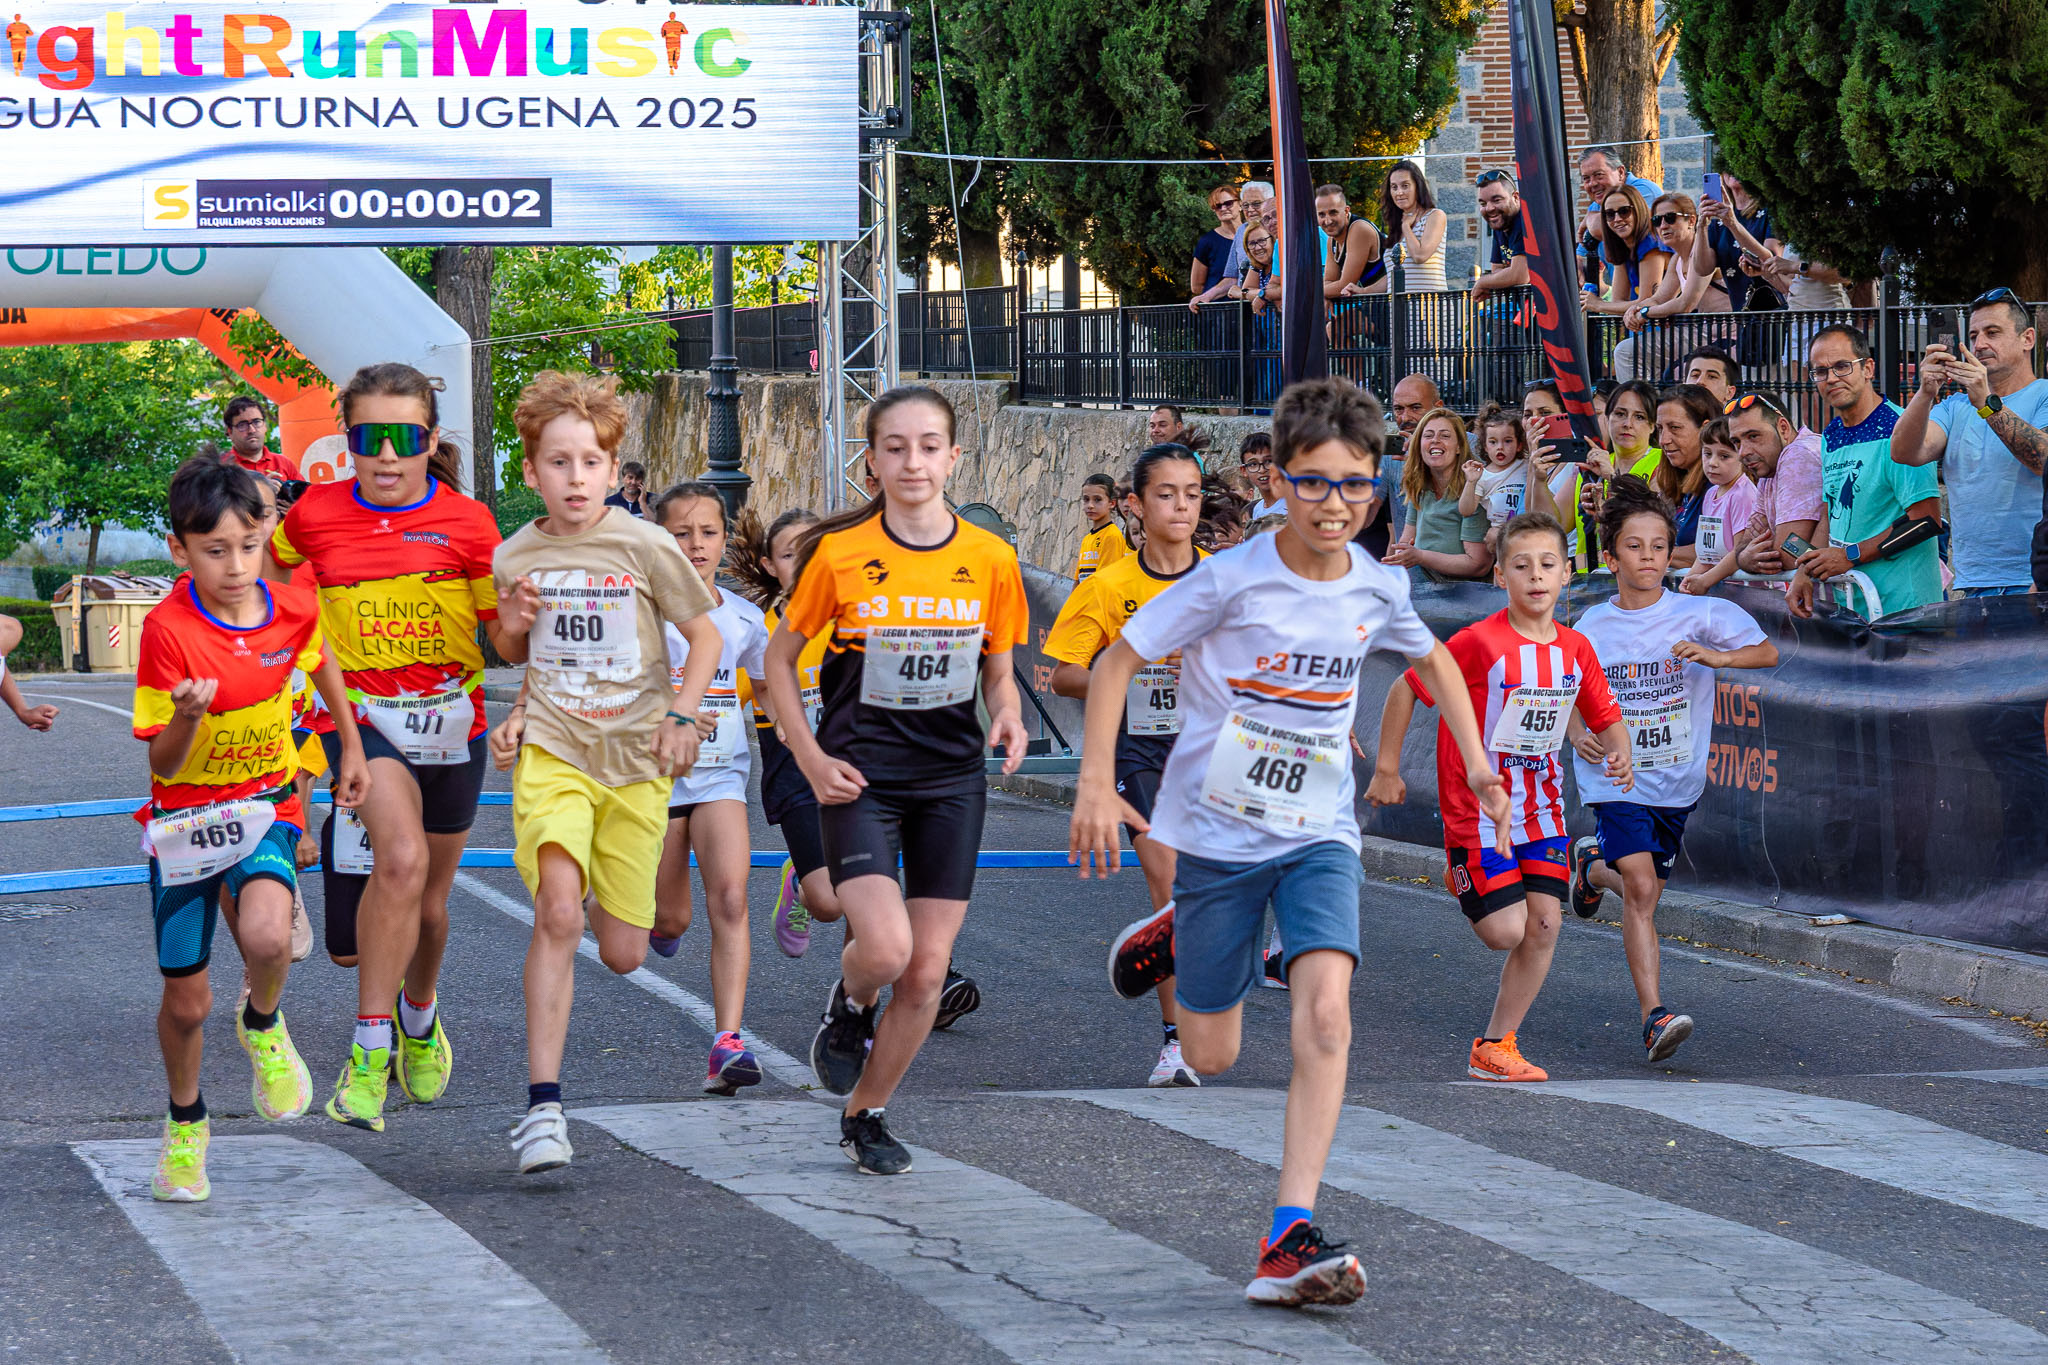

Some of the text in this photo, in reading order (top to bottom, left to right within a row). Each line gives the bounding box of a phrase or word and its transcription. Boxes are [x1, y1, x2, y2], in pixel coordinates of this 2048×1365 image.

[121, 97, 419, 129] NOCTURNA
[438, 97, 620, 129] UGENA
[637, 97, 757, 129] 2025
[200, 189, 541, 218] sumialki 00:00:02
[200, 216, 326, 227] ALQUILAMOS SOLUCIONES
[1703, 532, 1716, 549] 407
[538, 587, 630, 598] EGUA NOCTURNA UGENA
[358, 597, 444, 619] CLÍNICA
[857, 596, 981, 621] e3 TEAM
[359, 620, 444, 639] LACASA
[554, 614, 604, 642] 460
[910, 629, 954, 638] NOCTURNA
[361, 640, 446, 657] LITNER
[899, 654, 951, 681] 464
[1639, 672, 1684, 688] #SEVILLA10
[401, 697, 442, 709] NOCTURNA
[583, 689, 641, 710] SPRINGS
[1149, 688, 1177, 710] 45
[1640, 706, 1670, 717] NOCTURNA
[1671, 702, 1687, 712] UGENA
[1520, 709, 1558, 732] 455
[215, 719, 285, 746] CLÍNICA
[1636, 725, 1672, 749] 454
[208, 738, 284, 761] LACASA
[1504, 756, 1542, 770] RIYADH
[1247, 756, 1307, 794] 468
[190, 821, 245, 849] 469
[1452, 864, 1471, 895] 10
